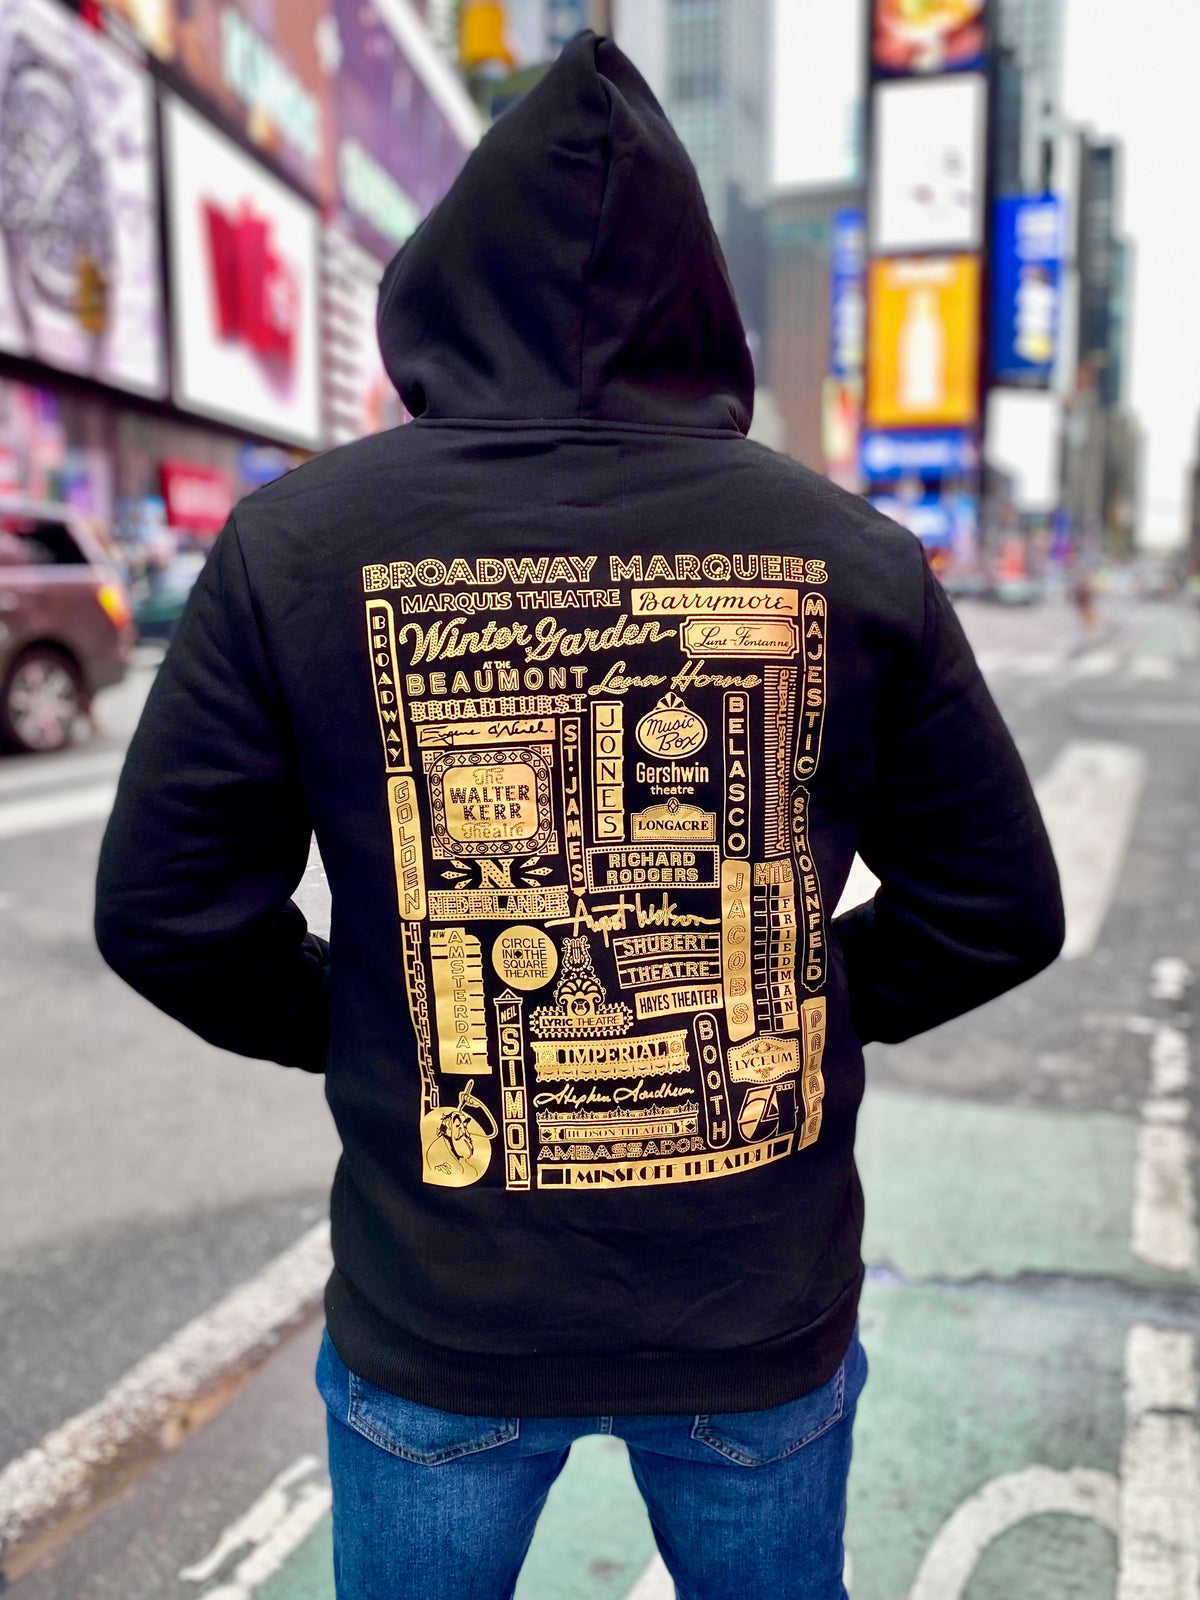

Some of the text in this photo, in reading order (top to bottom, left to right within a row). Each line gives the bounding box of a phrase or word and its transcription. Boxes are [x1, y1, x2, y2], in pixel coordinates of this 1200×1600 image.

[362, 554, 829, 592] BROADWAY MARQUEES
[401, 589, 622, 615] MARQUIS THEATRE
[639, 591, 793, 611] Barrymore
[399, 615, 677, 666] Winter Garden
[482, 660, 511, 670] AT THE
[405, 666, 588, 696] BEAUMONT
[588, 659, 762, 695] Lena Horne
[797, 599, 825, 774] MAJESTIC
[372, 615, 401, 762] BROADWAY
[409, 694, 587, 722] BROADHURST
[646, 715, 695, 737] Music
[656, 732, 700, 752] Box
[599, 708, 618, 834] JONES
[636, 762, 709, 783] Gershwin
[727, 697, 746, 852] BELASCO
[449, 785, 530, 804] WALTER
[650, 785, 694, 795] theatre
[463, 803, 522, 821] KERR
[637, 820, 709, 832] LONGACRE
[394, 781, 421, 914] GOLDEN
[608, 852, 696, 868] RICHARD
[606, 868, 699, 884] RODGERS
[754, 859, 793, 885] MTC
[792, 797, 822, 981] SCHOENFELD
[429, 892, 570, 915] NEDERLANDER
[431, 930, 446, 940] NEW
[501, 938, 547, 949] CIRCLE
[622, 935, 708, 957] SHUBERT
[502, 949, 547, 960] IN THE
[727, 872, 751, 1026] JACOBS
[780, 898, 794, 1014] FRIEDMAN
[503, 959, 548, 969] SQUARE
[504, 969, 548, 979] THEATRE
[626, 961, 710, 985] THEATRE
[448, 930, 473, 1066] AMSTERDAM
[639, 990, 719, 1014] HAYES THEATER
[500, 1005, 517, 1023] NEIL
[542, 1015, 620, 1027] LYRIC THEATRE
[563, 1042, 669, 1064] IMPERIAL
[735, 1051, 793, 1071] LYCEUM
[699, 1020, 727, 1140] BOOTH
[502, 1028, 526, 1181] SIMON
[567, 1124, 672, 1138] HUDSON THEATRE
[537, 1137, 707, 1161] AMBASSADOR
[574, 1163, 677, 1184] MINSKOFF
